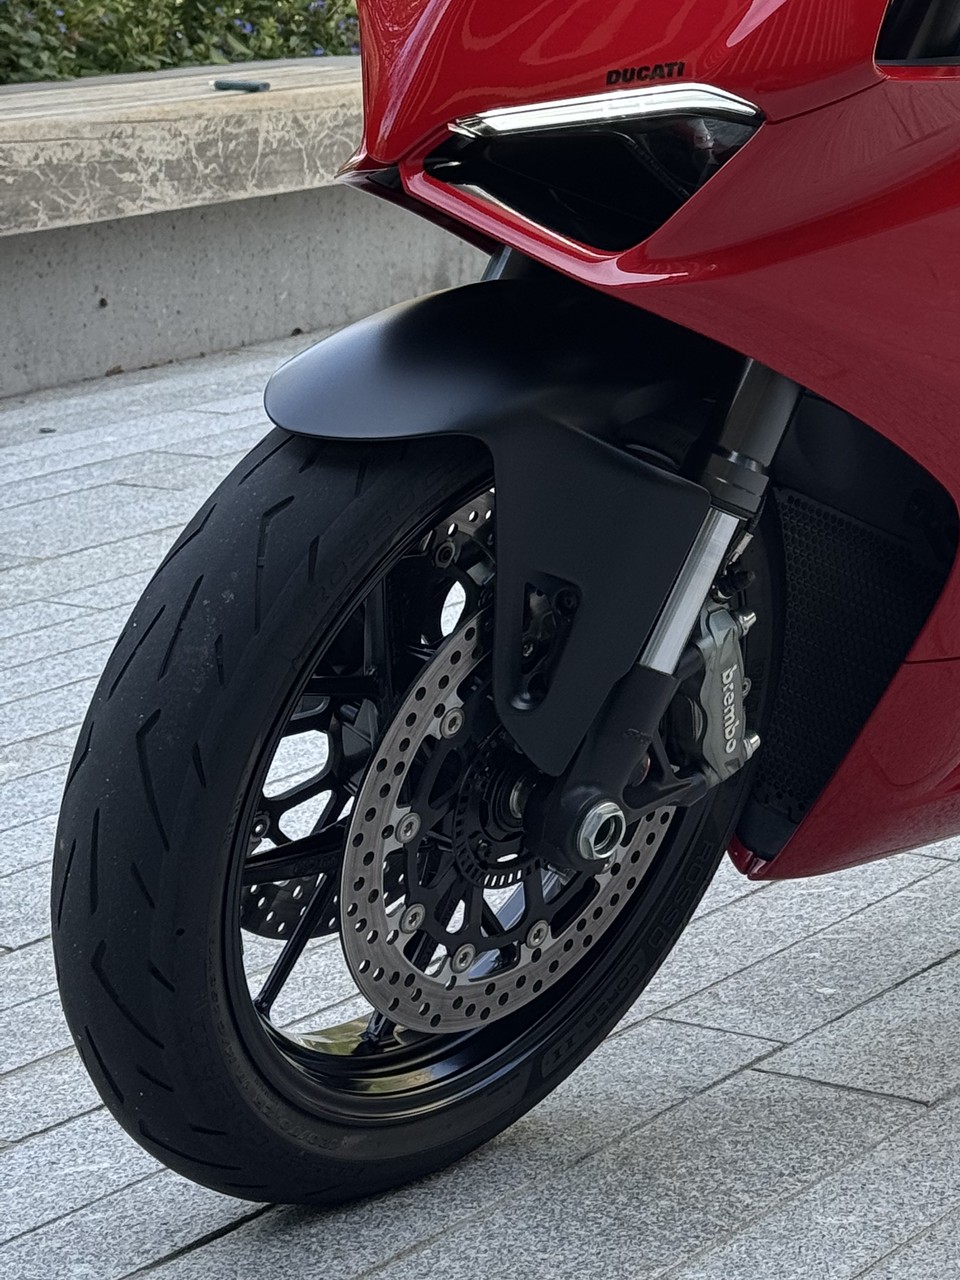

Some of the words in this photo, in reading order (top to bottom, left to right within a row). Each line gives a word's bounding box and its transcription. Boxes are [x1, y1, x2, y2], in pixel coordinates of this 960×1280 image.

[606, 62, 686, 85] DUCATI
[722, 664, 740, 753] brembo
[649, 841, 714, 950] ROSSO
[584, 963, 642, 1027] CORSA
